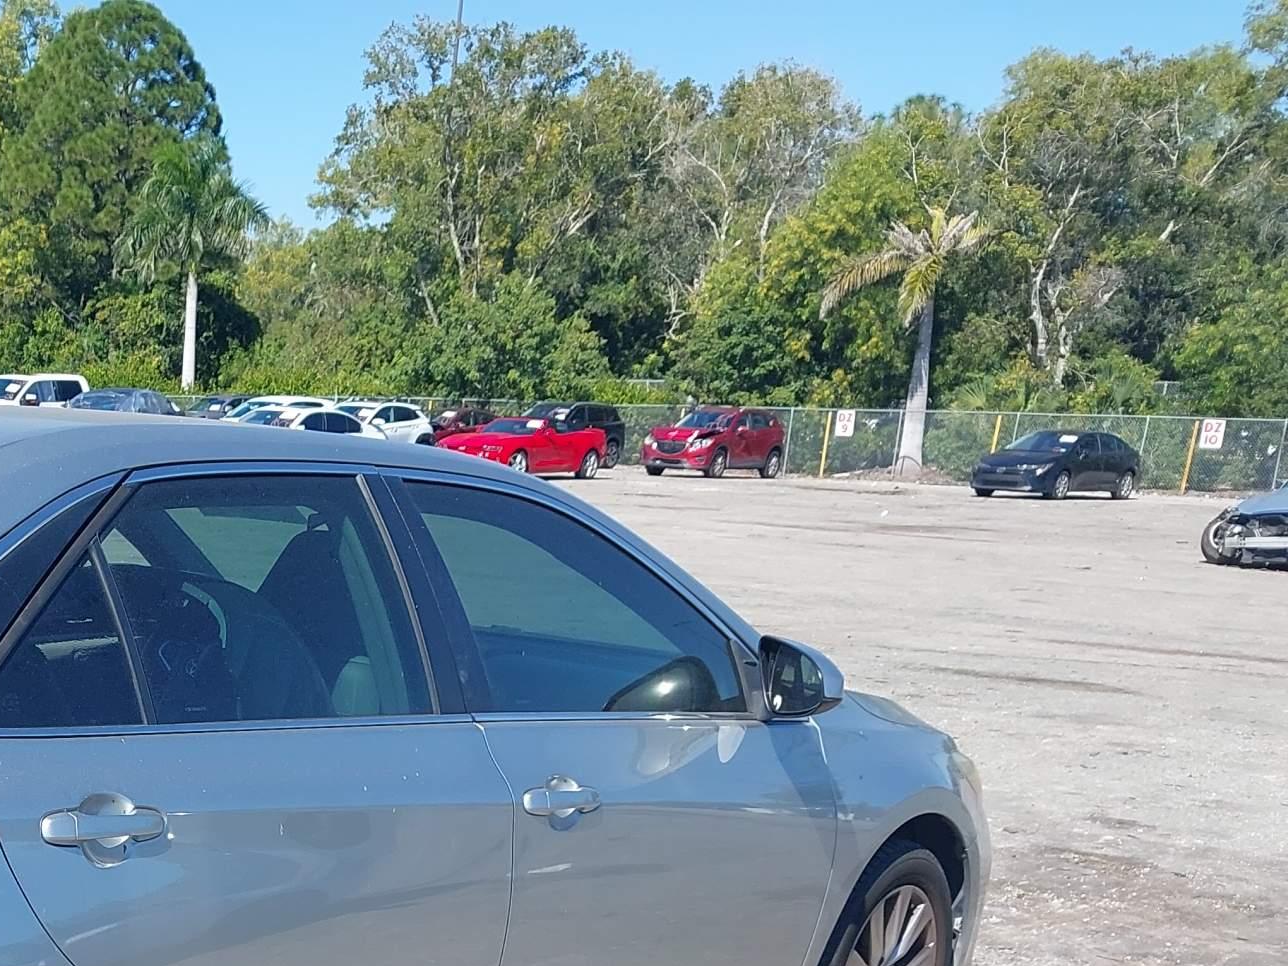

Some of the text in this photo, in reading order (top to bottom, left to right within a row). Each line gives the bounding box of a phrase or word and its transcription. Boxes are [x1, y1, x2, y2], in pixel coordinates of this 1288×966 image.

[838, 412, 853, 422] DZ
[841, 423, 848, 433] 9
[1204, 422, 1222, 433] DZ
[1204, 434, 1218, 445] 10
